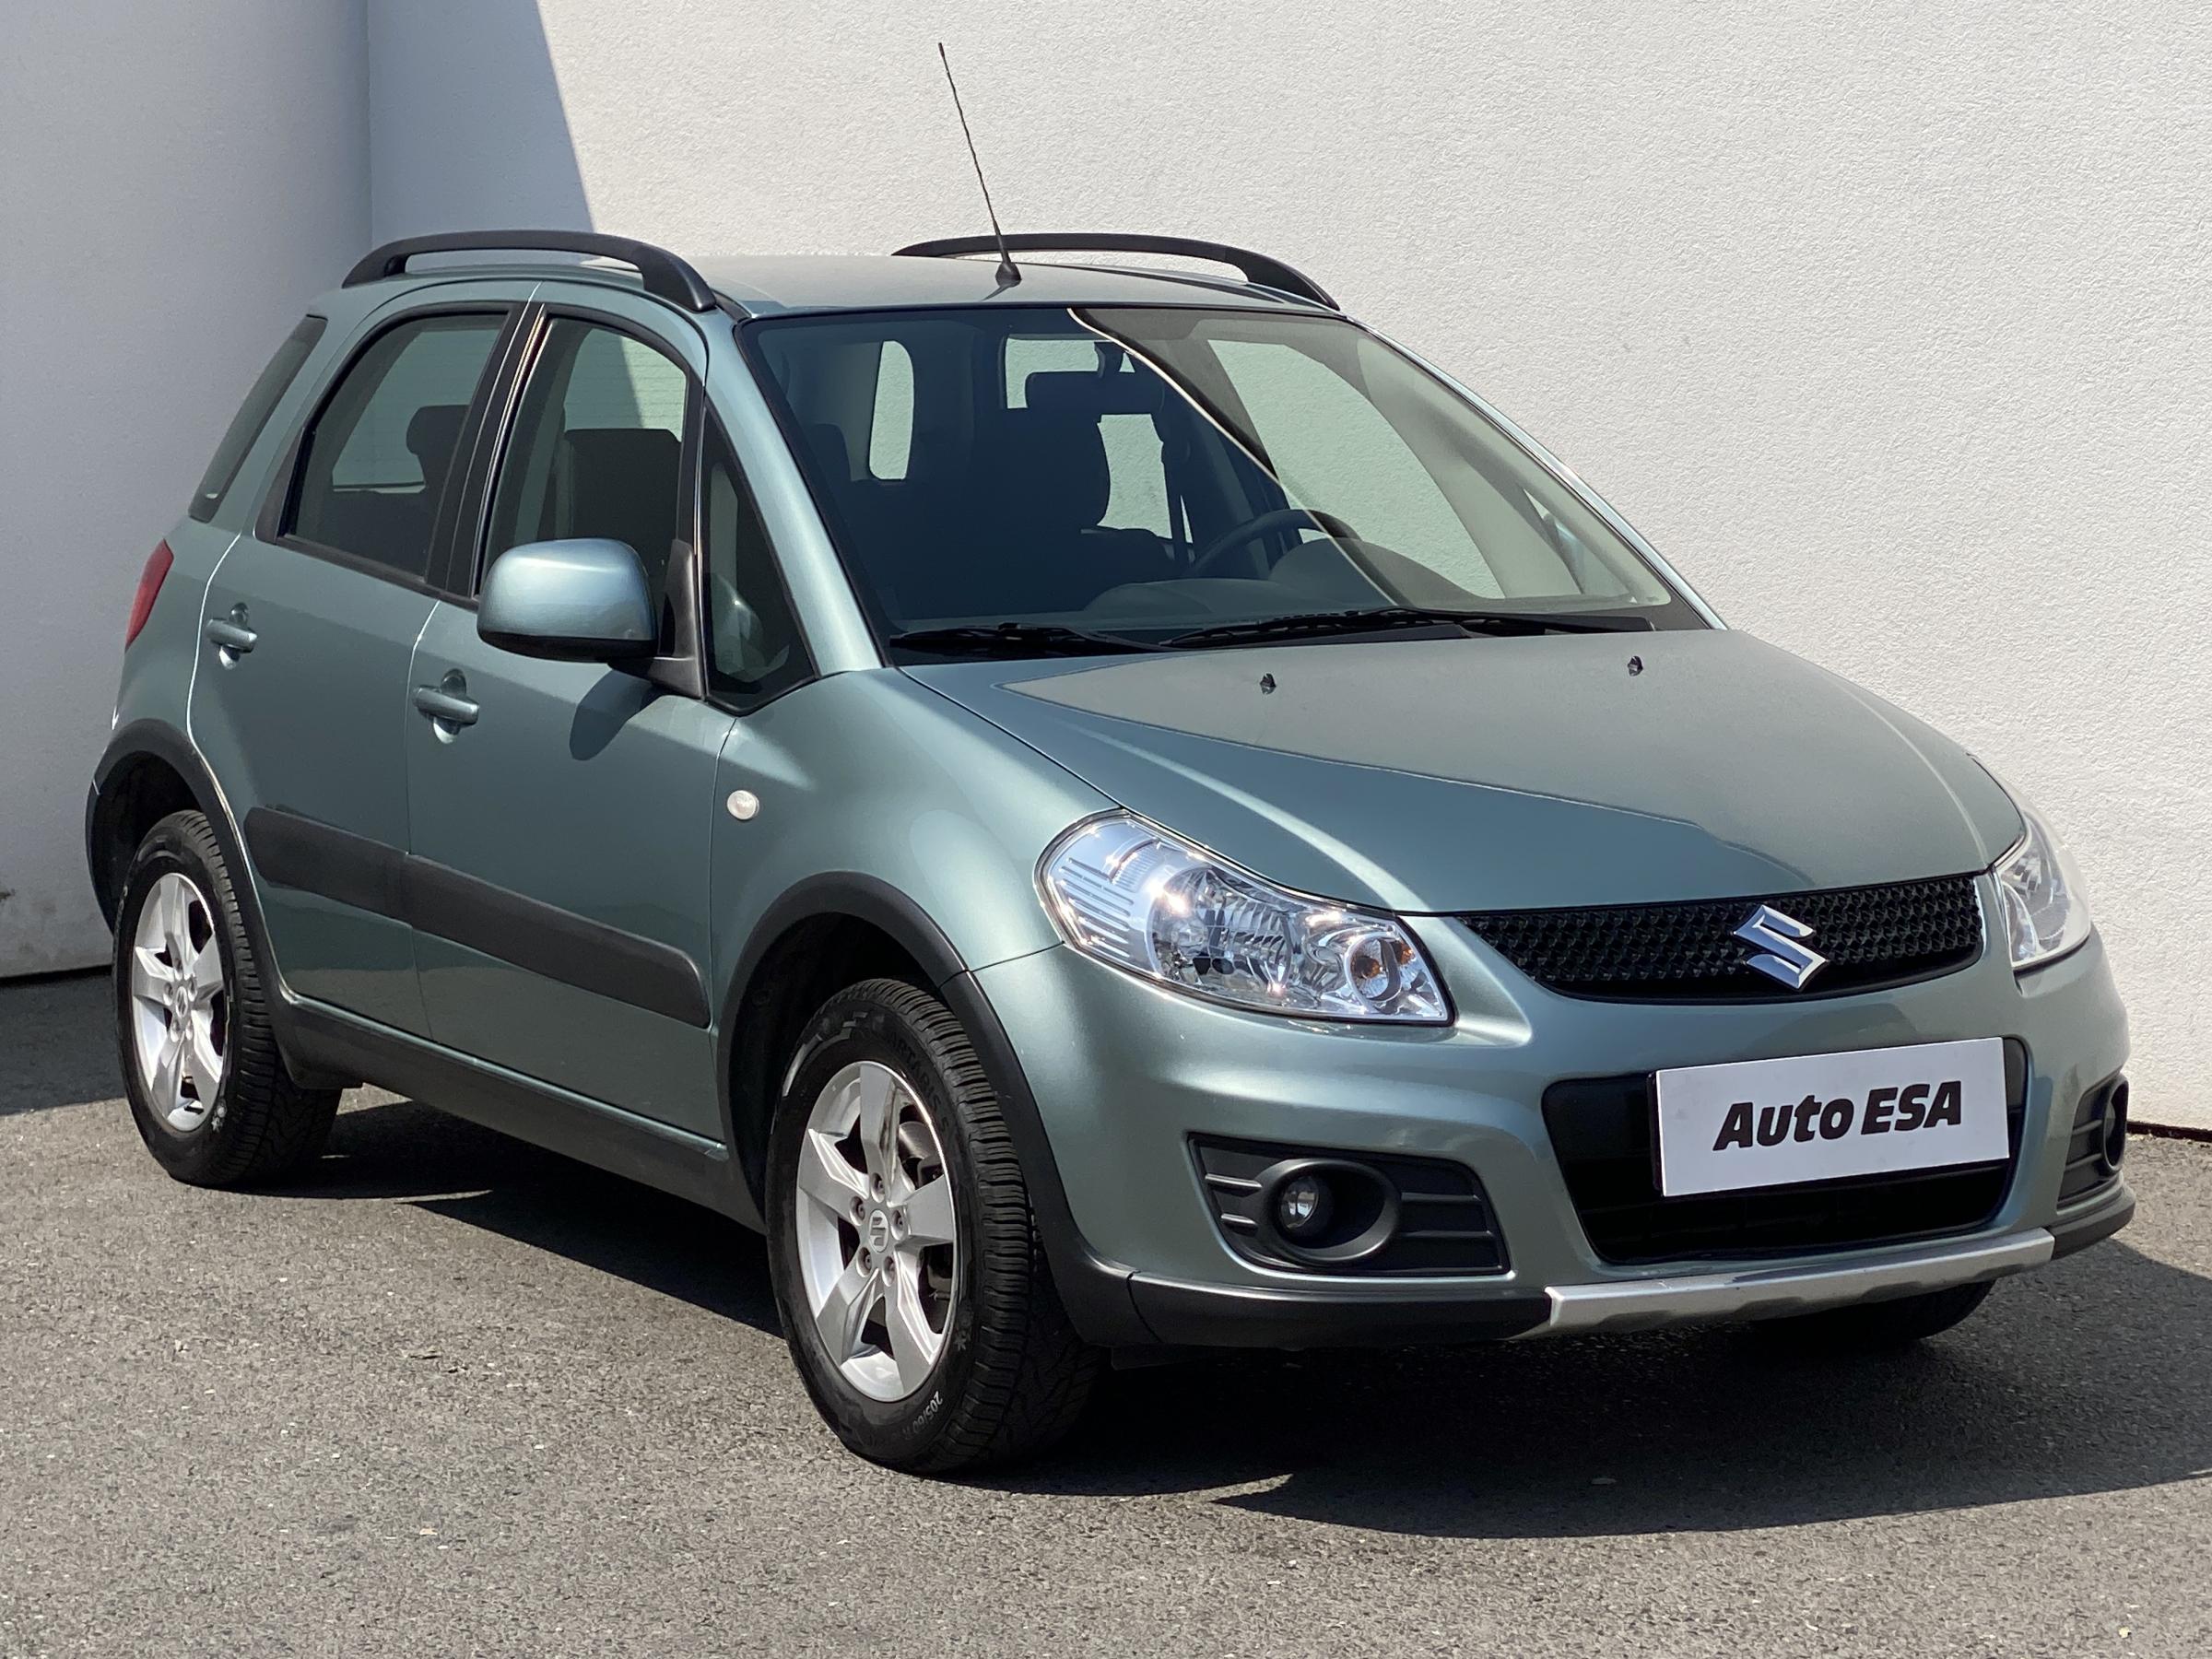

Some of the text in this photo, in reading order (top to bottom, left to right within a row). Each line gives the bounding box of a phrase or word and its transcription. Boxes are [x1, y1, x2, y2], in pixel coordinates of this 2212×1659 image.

[1712, 1080, 1962, 1151] Auto ESA
[912, 1389, 944, 1435] 205/60
